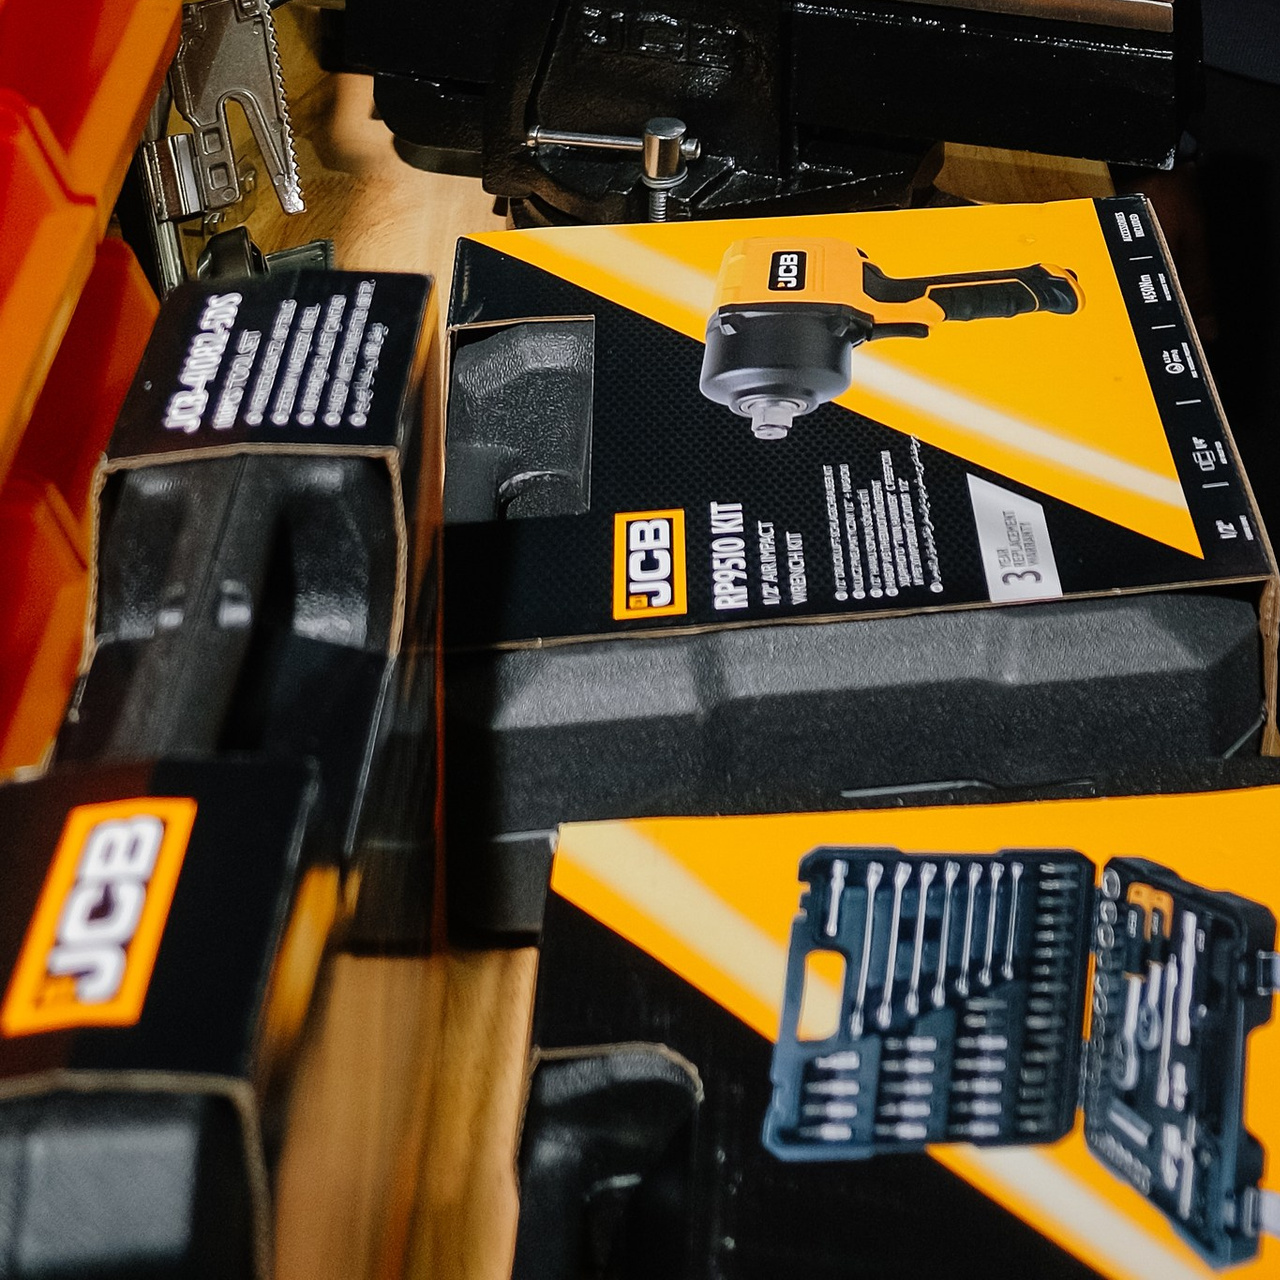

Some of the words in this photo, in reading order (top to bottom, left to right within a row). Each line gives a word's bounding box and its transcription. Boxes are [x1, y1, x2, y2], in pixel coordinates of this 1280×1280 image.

[778, 253, 798, 287] JCB
[1138, 274, 1158, 303] 1450Nm
[710, 501, 744, 534] KIT
[757, 520, 777, 562] IMPACT
[786, 530, 803, 551] KIT
[629, 518, 671, 608] JCB
[712, 536, 748, 610] RP9510
[760, 562, 778, 582] AIR
[788, 551, 807, 605] WRENCH
[1002, 570, 1042, 585] 3
[48, 814, 164, 1004] JCB
